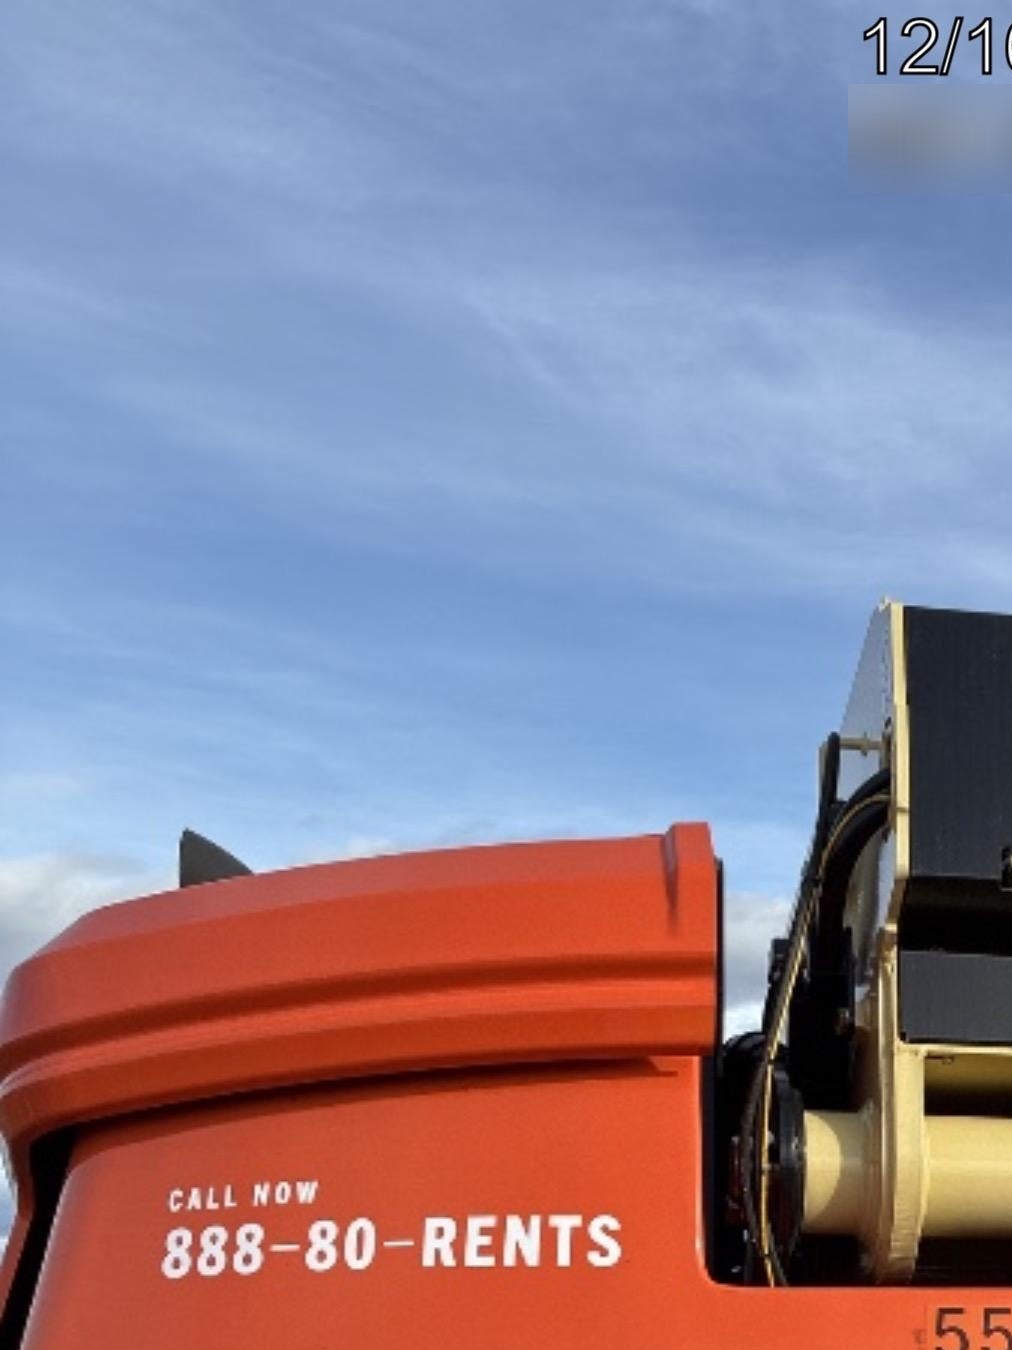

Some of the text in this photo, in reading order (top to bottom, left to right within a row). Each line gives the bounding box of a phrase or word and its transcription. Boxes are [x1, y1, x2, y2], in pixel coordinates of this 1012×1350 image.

[168, 1181, 319, 1212] CALL NOW
[161, 1214, 623, 1279] 888-80-RENTS
